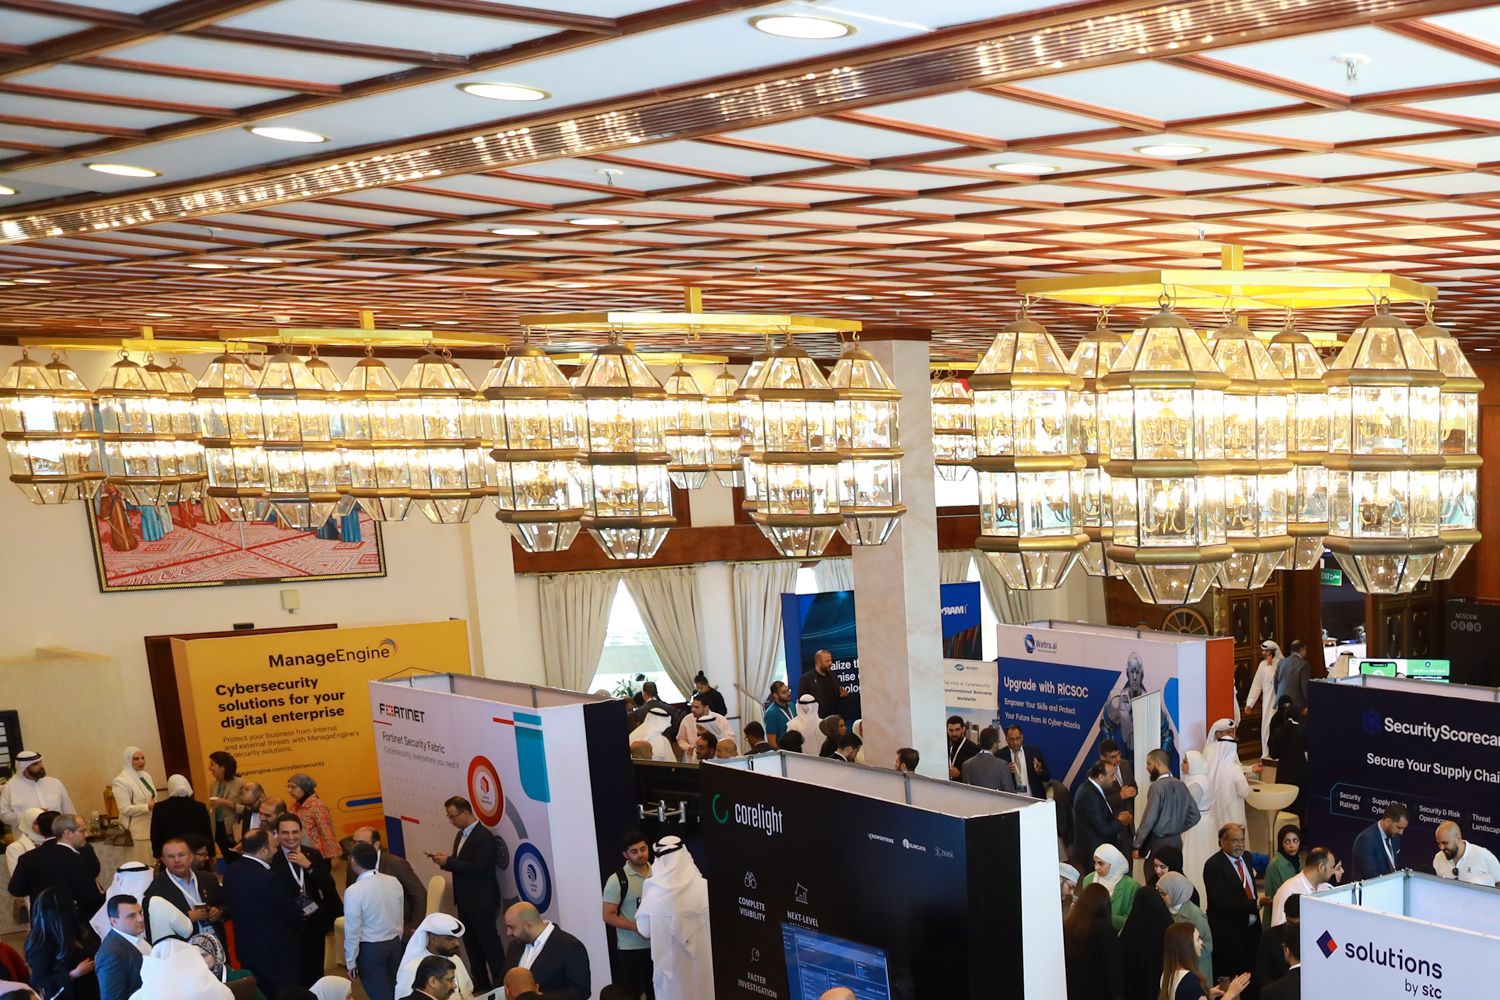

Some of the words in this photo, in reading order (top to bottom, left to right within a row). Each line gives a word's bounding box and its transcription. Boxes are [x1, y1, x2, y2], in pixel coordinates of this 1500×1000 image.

[1321, 572, 1330, 580] EXIT
[1455, 612, 1478, 620] NCSCKW
[268, 647, 390, 668] ManageEngine
[830, 660, 851, 670] alize
[216, 676, 318, 697] Cybersecurity
[1003, 676, 1037, 692] Upgrade
[1039, 681, 1055, 694] with
[218, 696, 285, 712] solutions
[289, 693, 309, 705] for
[314, 691, 345, 704] your
[1004, 698, 1025, 708] Empower
[1026, 701, 1035, 709] Your
[1036, 701, 1048, 711] Skills
[1049, 703, 1058, 712] and
[1059, 705, 1076, 715] Protect
[221, 712, 267, 729] digital
[271, 706, 345, 723] enterprise
[379, 703, 425, 723] FORTINET
[1005, 712, 1015, 720] Your
[1016, 713, 1030, 722] Future
[1031, 715, 1041, 723] from
[1042, 717, 1047, 725] AI
[1048, 718, 1081, 730] Cyber-Attacks
[239, 741, 266, 749] external
[267, 738, 290, 746] threats
[307, 730, 360, 742] ManageEngine's
[266, 731, 295, 739] business
[313, 725, 338, 733] internal
[382, 731, 404, 745] Fortinet
[404, 736, 426, 751] Security
[427, 741, 445, 754] Fabric
[233, 750, 260, 758] security
[238, 761, 325, 777] ageengine.com/cybersecurity
[1367, 752, 1404, 769] Secure
[1406, 758, 1431, 773] Your
[1433, 762, 1471, 781] Supply
[1340, 792, 1361, 802] Security
[1372, 797, 1390, 806] Supply
[1340, 801, 1360, 810] Ratings
[1419, 805, 1441, 816] Security
[1448, 810, 1461, 818] Risk
[735, 803, 783, 836] corelight
[1472, 813, 1491, 824] Threat
[738, 896, 765, 911] COMPLETE
[739, 907, 766, 922] VISIBILITY
[787, 911, 819, 927] NEXT-LEVEL
[1345, 941, 1443, 980] solutions
[748, 972, 766, 985] FASTER
[738, 979, 778, 999] INVESTIGATION
[1404, 978, 1418, 997] by
[1421, 984, 1443, 1000] stc
